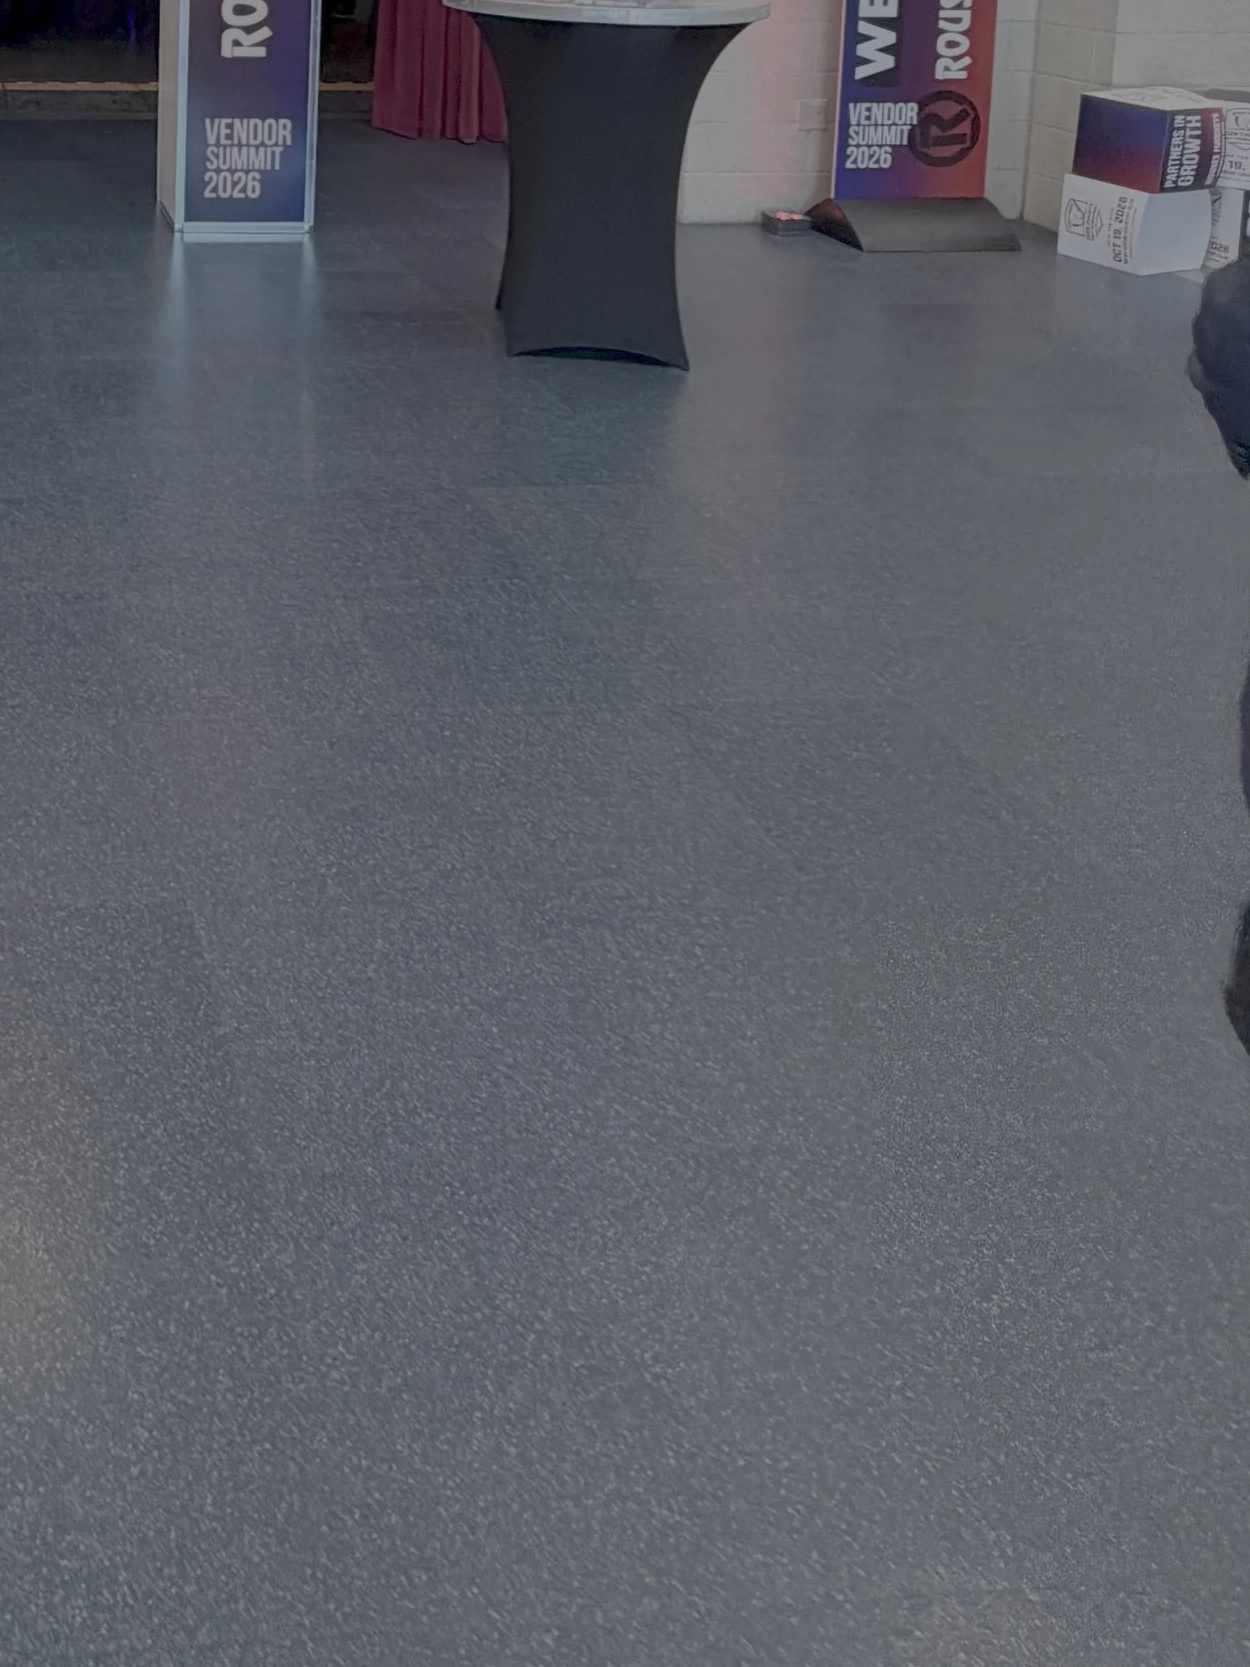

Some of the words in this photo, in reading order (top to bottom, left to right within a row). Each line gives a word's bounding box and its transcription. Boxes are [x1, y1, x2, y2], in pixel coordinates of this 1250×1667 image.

[848, 102, 918, 126] VENDOR
[1173, 115, 1186, 129] IN
[204, 118, 293, 146] VENDOR
[848, 124, 912, 146] SUMMIT
[205, 145, 284, 171] SUMMIT
[845, 146, 892, 169] 2026
[1163, 130, 1185, 188] PARTNERS
[1177, 115, 1202, 187] GROWTH
[203, 171, 261, 199] 2026
[1113, 242, 1123, 263] OCT
